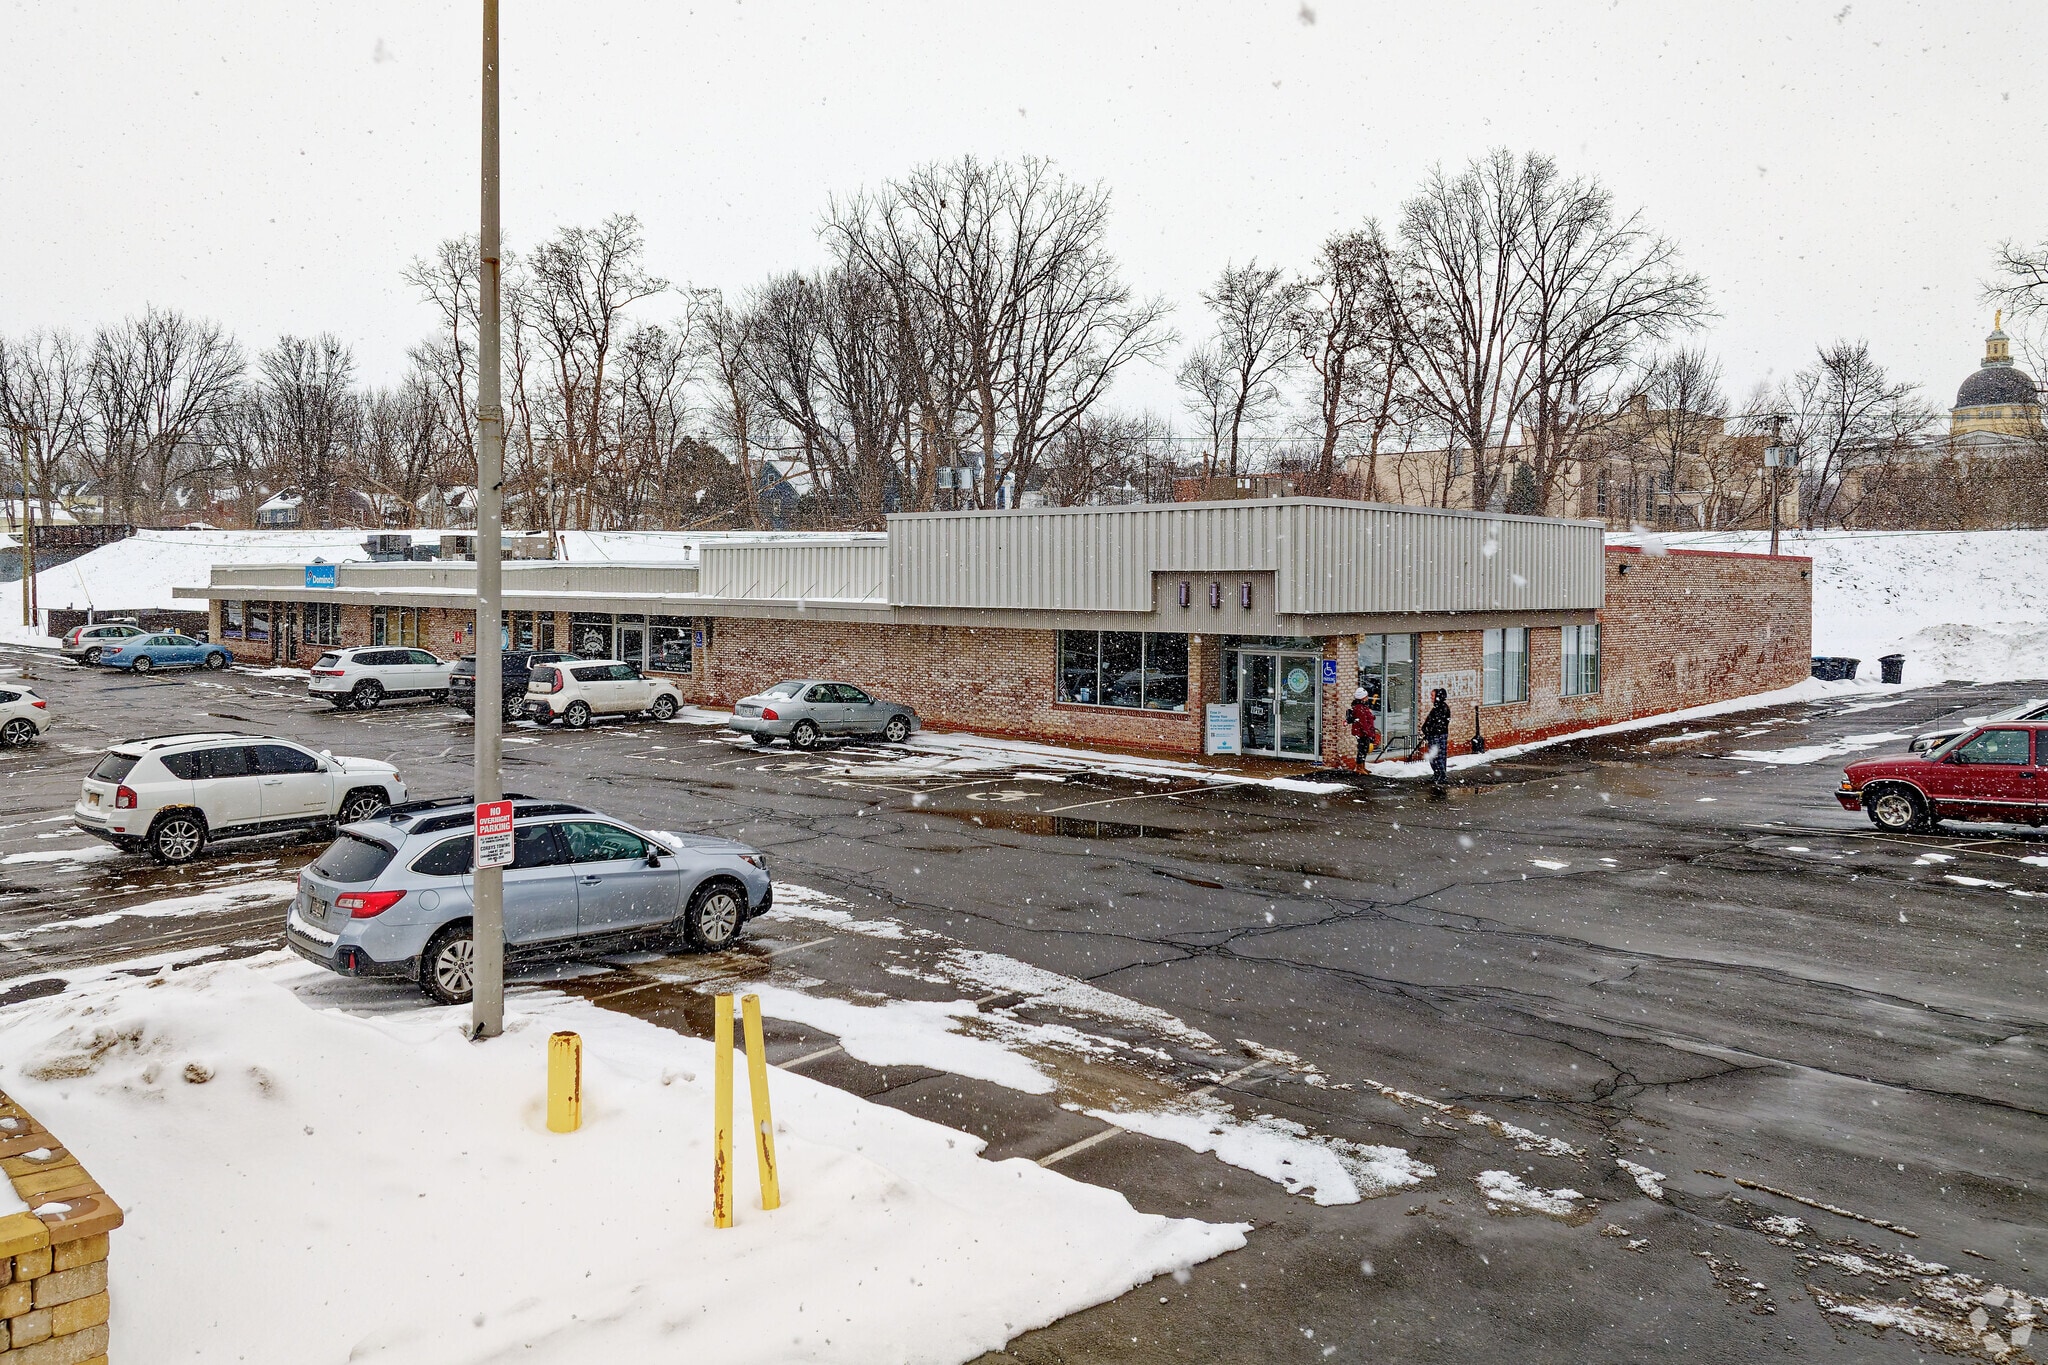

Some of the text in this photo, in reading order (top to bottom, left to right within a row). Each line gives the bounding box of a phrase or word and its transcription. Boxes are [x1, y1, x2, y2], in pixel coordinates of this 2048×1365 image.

[312, 574, 334, 584] Domino's
[490, 807, 501, 816] NO
[480, 815, 510, 824] OVERNIGHT
[480, 822, 510, 834] PARKING
